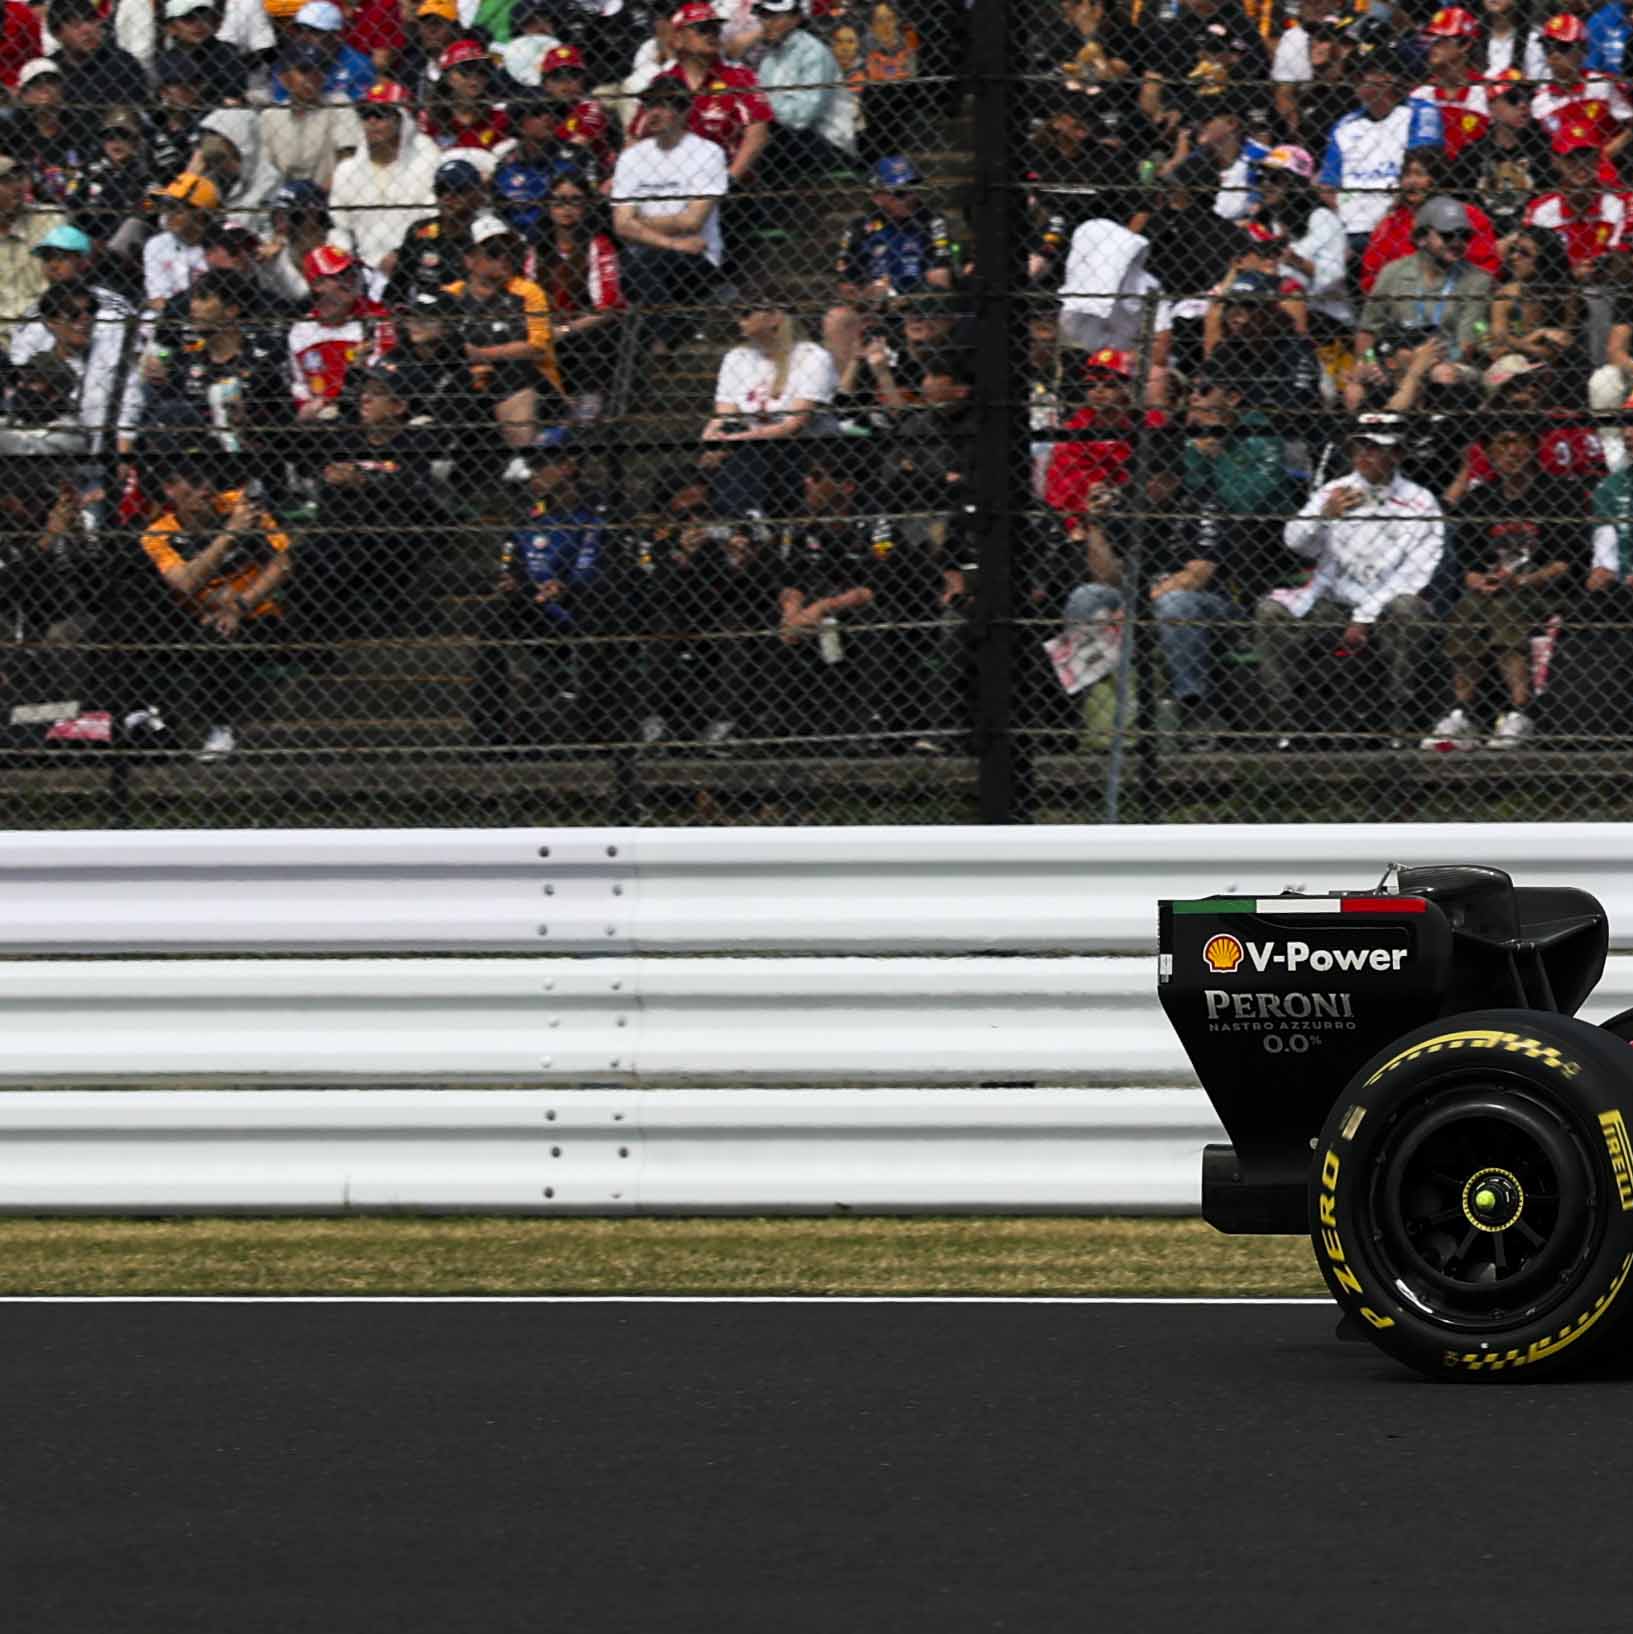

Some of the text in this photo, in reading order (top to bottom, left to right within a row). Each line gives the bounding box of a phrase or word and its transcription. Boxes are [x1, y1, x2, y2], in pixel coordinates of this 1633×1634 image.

[1245, 941, 1408, 972] V-Power
[1204, 990, 1355, 1020] PERONI
[1209, 1021, 1357, 1032] NASTRO AZZURRO
[1319, 1150, 1363, 1294] ZERO
